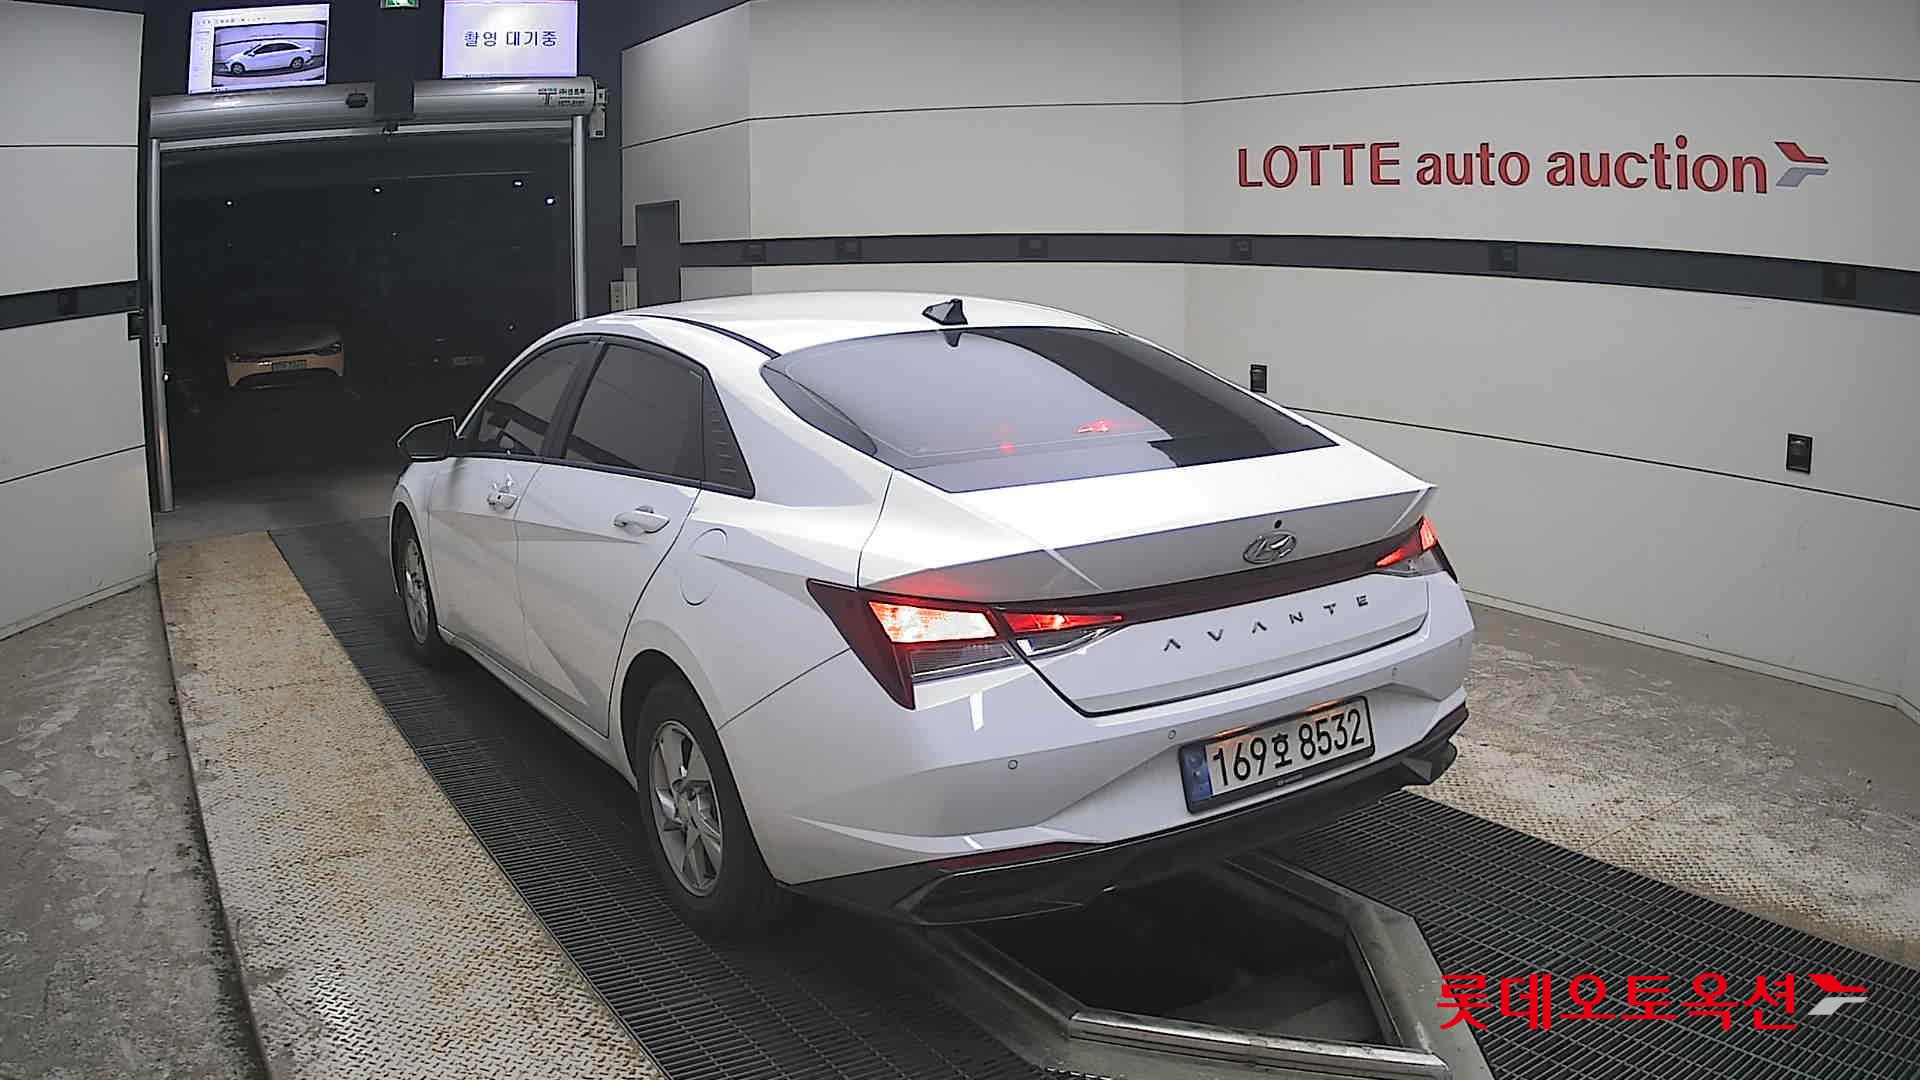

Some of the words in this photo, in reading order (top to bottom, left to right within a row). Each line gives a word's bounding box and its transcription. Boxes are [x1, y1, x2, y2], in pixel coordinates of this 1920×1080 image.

[464, 30, 497, 47] 촬영
[505, 30, 558, 47] 대기중
[1238, 142, 1400, 188] LOTTE
[1416, 143, 1531, 186] auto
[1545, 135, 1768, 194] auction
[1163, 595, 1369, 652] AVANTE
[1212, 732, 1293, 786] 169호
[1299, 708, 1365, 760] 8532
